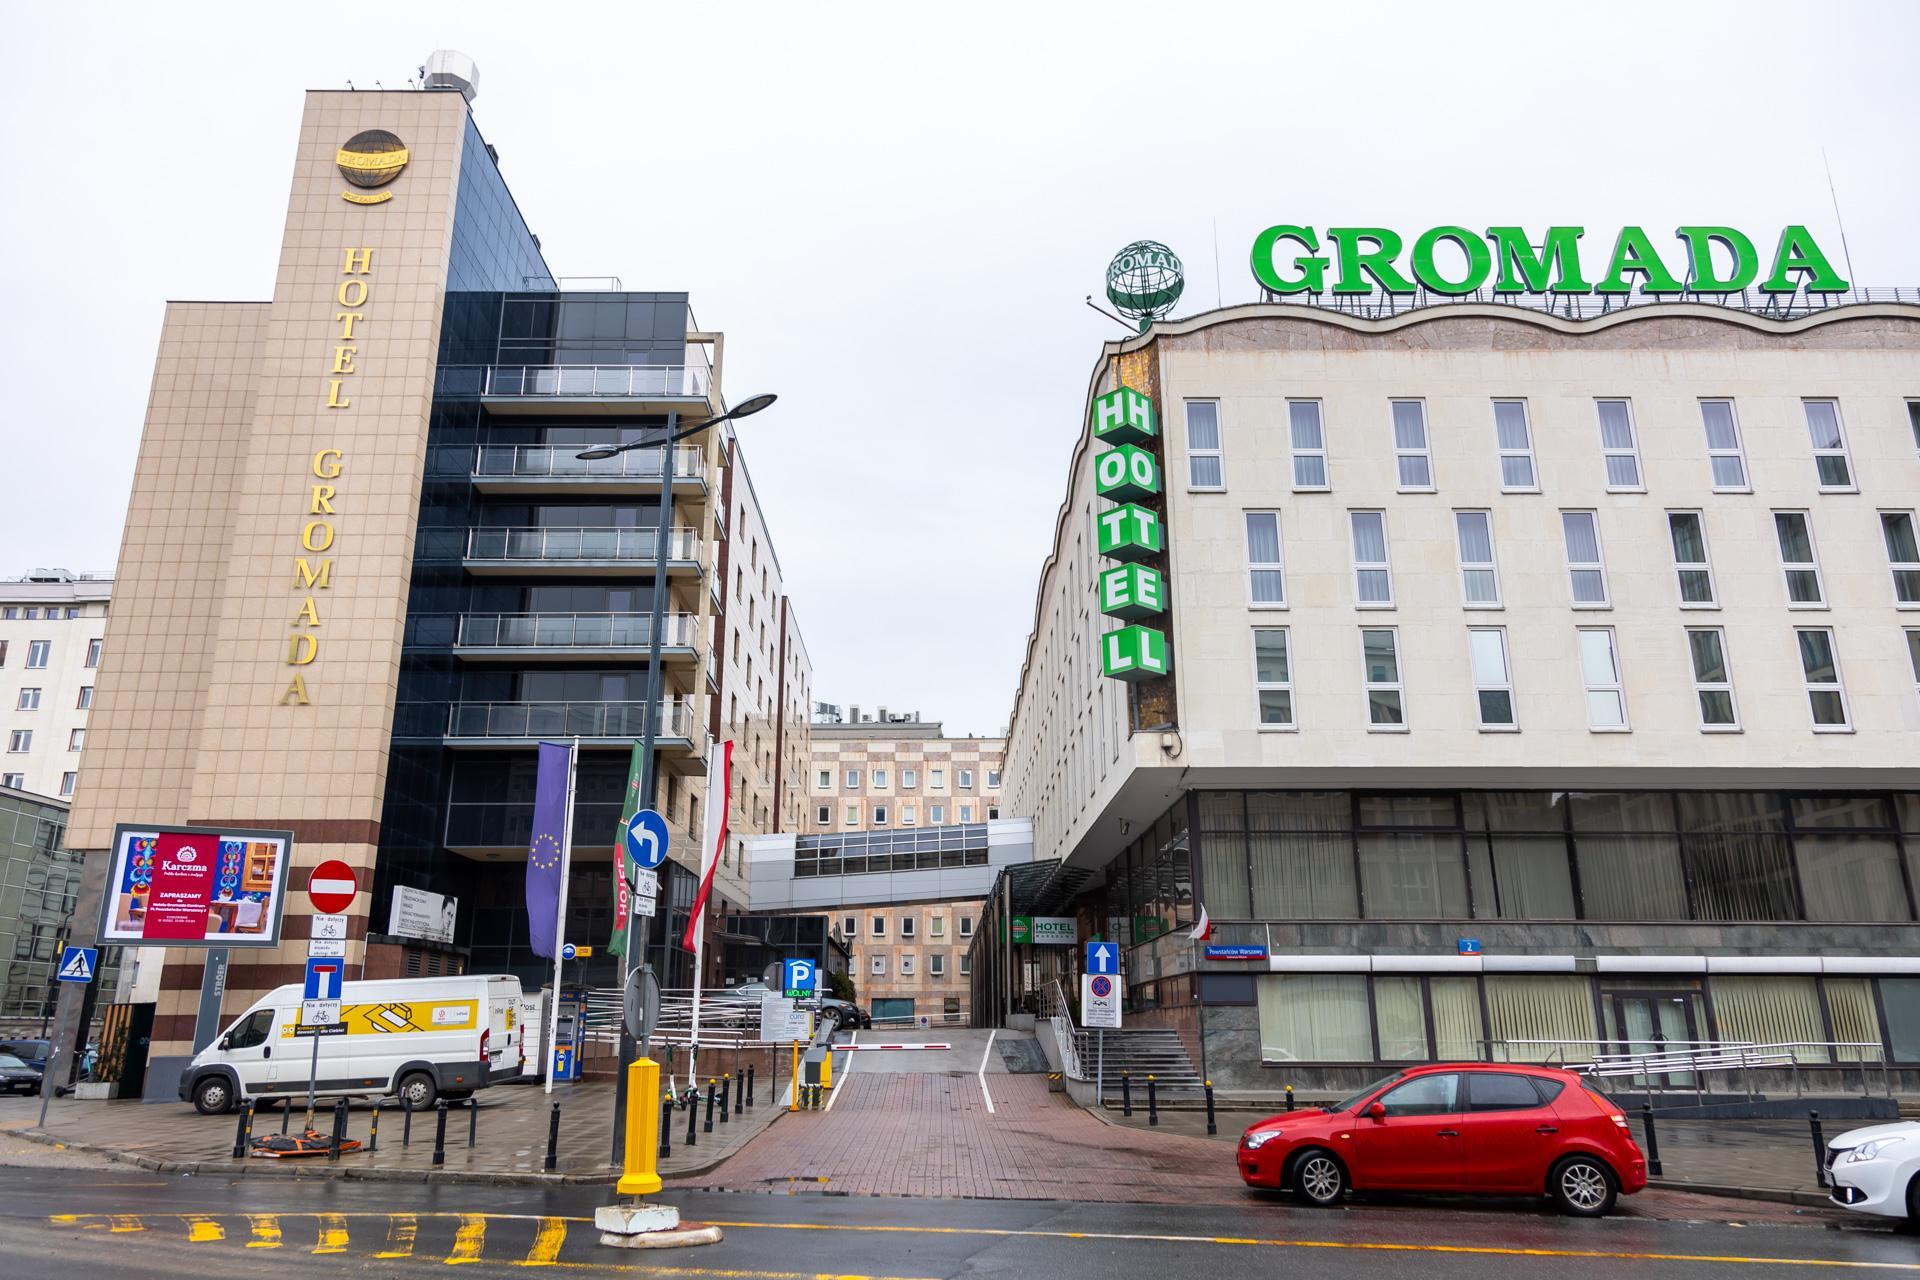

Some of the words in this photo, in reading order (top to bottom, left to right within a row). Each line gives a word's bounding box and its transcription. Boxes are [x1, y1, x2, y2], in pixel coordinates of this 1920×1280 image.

[1249, 224, 1850, 297] GROMADA
[325, 247, 373, 408] HOTEL
[280, 449, 343, 705] GROMADA
[1097, 391, 1133, 671] HOTEL
[1128, 391, 1162, 670] HOTEL
[162, 860, 207, 872] Karczma
[1036, 923, 1074, 931] HOTEL
[1466, 942, 1473, 952] 2
